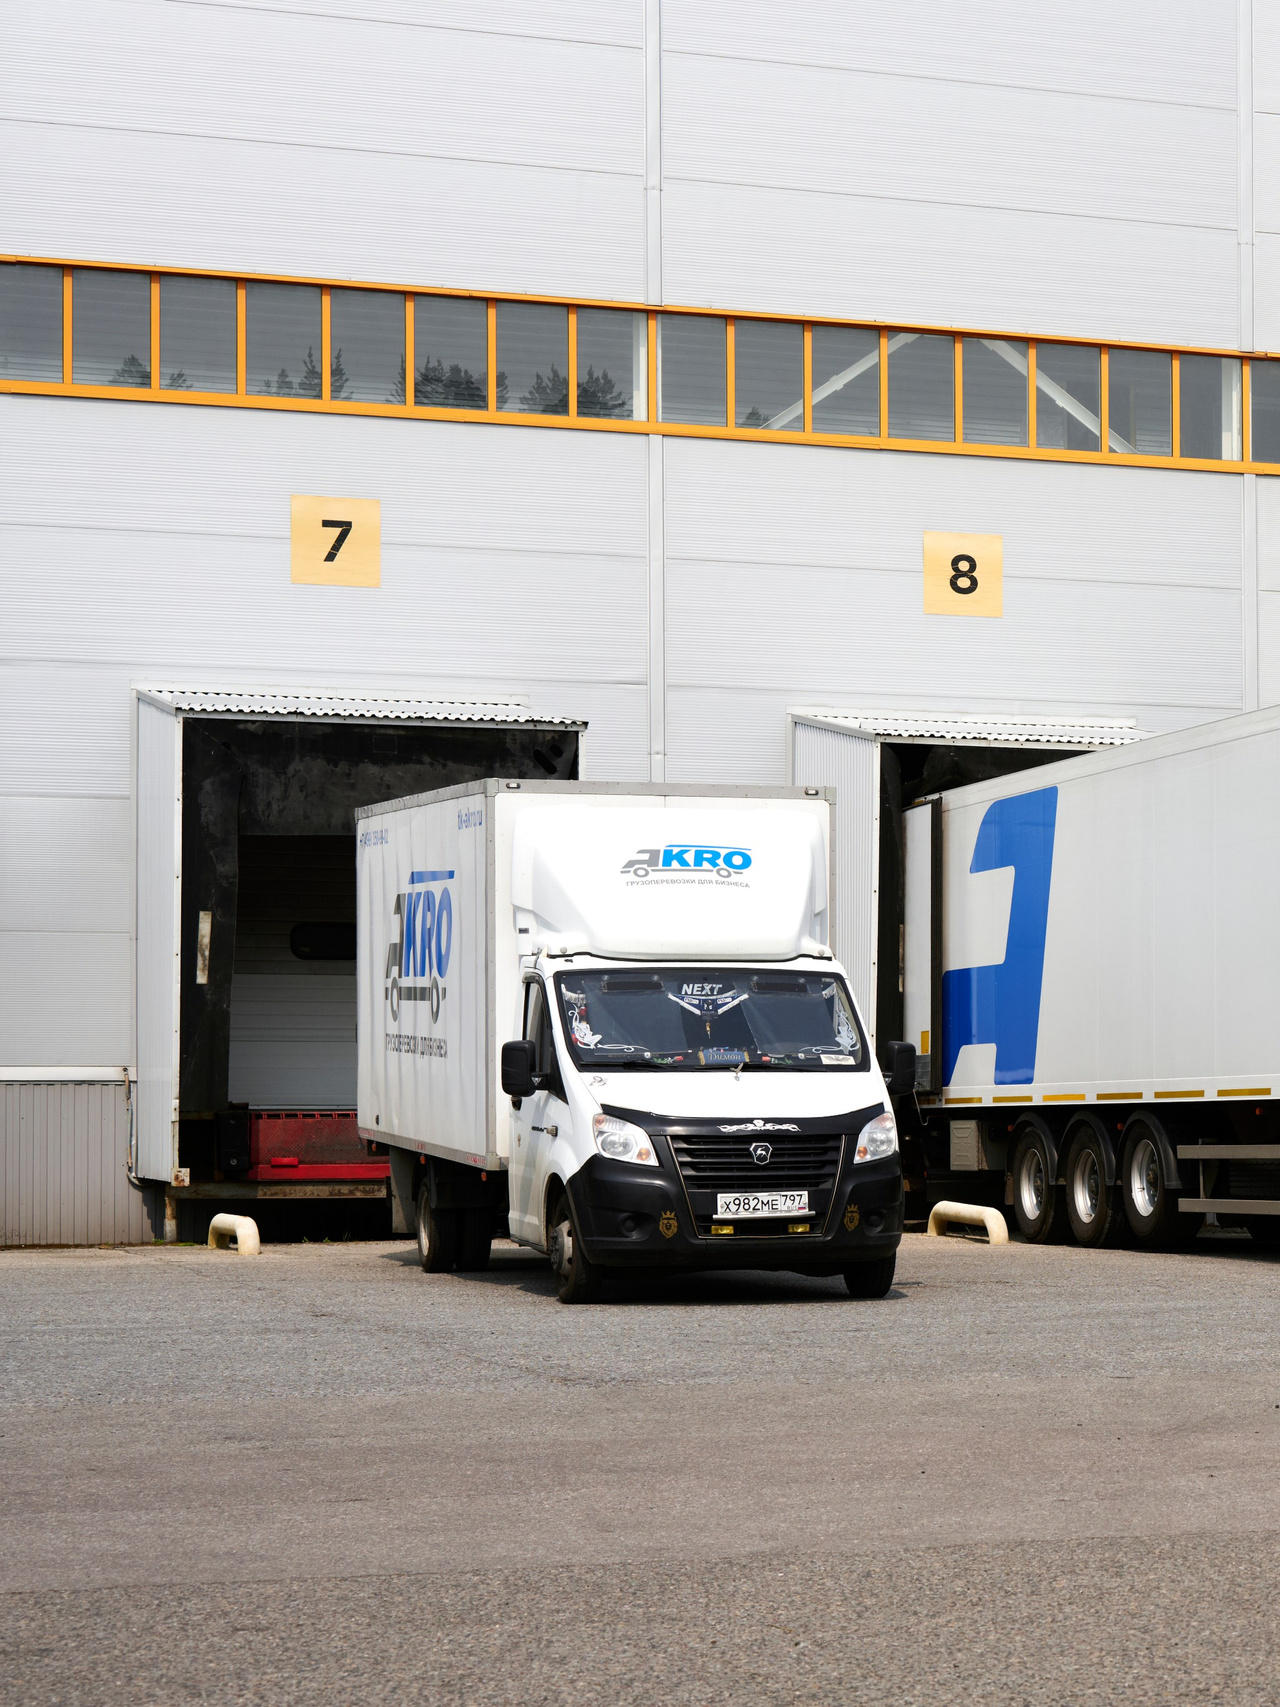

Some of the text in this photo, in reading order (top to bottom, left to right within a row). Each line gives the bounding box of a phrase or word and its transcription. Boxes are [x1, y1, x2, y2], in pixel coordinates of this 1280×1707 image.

[321, 519, 353, 562] 7
[949, 553, 978, 595] 8
[621, 848, 753, 871] AKRO
[625, 878, 697, 888] ГРУЗОПЕРЕВОЗКИ
[715, 879, 751, 889] БИЗНЕСА
[385, 886, 453, 980] AKRO
[681, 983, 723, 995] NEXT
[781, 1194, 804, 1206] 797
